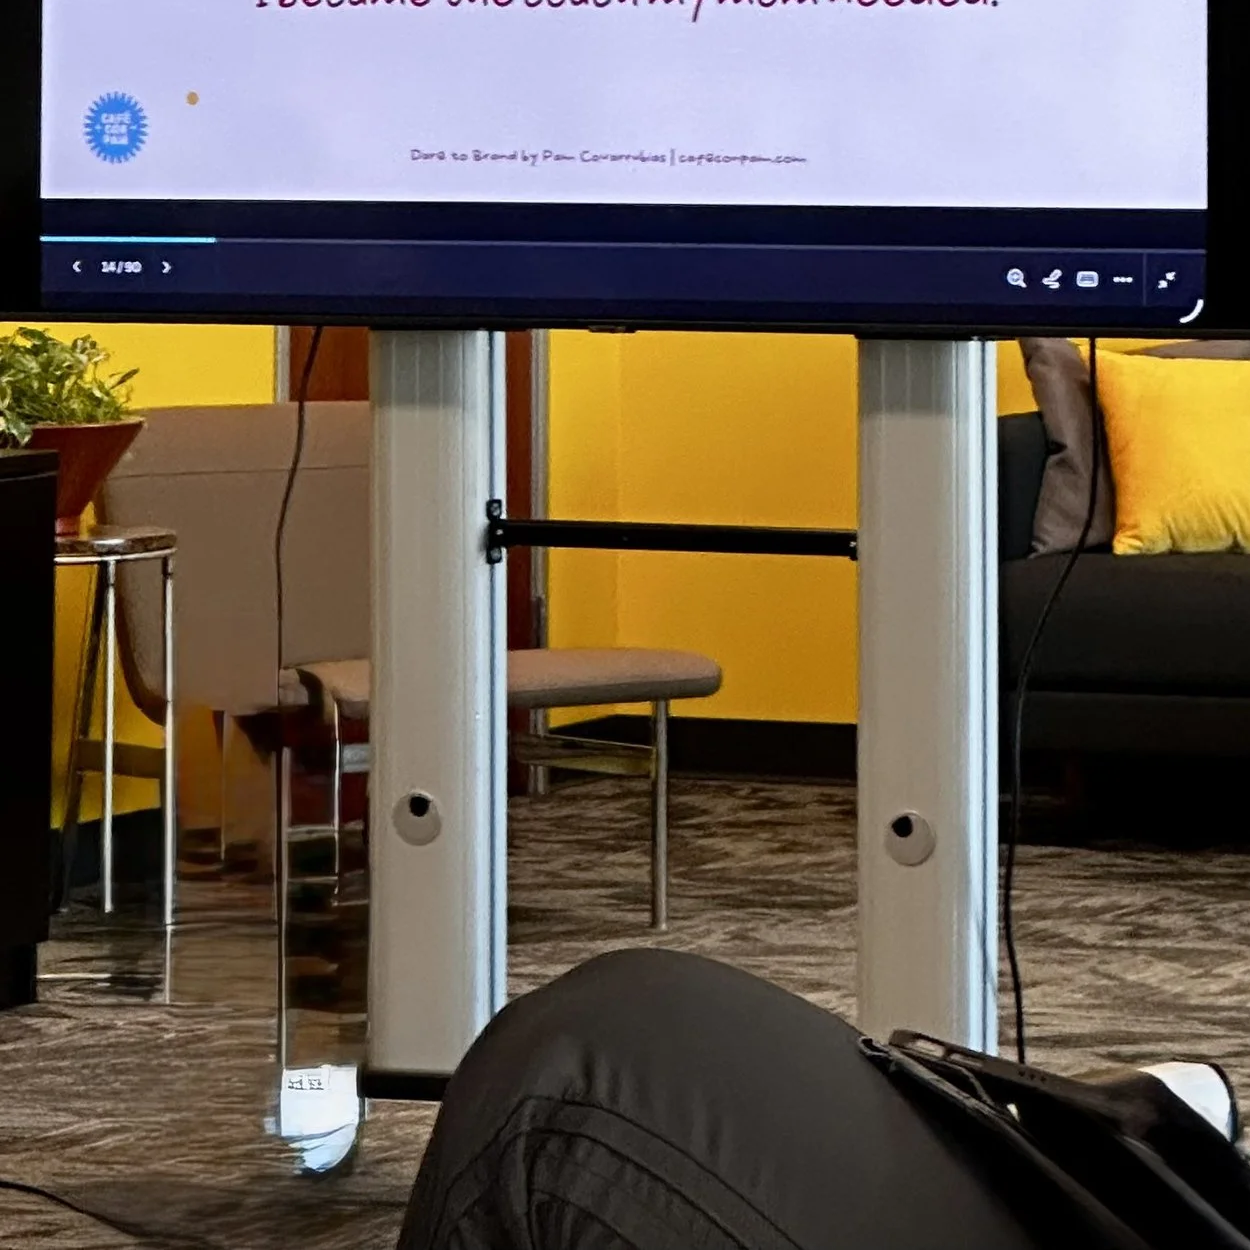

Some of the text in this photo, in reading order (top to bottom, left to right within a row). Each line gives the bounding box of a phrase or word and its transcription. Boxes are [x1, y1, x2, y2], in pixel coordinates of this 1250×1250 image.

[450, 150, 469, 162] to
[471, 148, 519, 162] Brand
[521, 148, 539, 168] by
